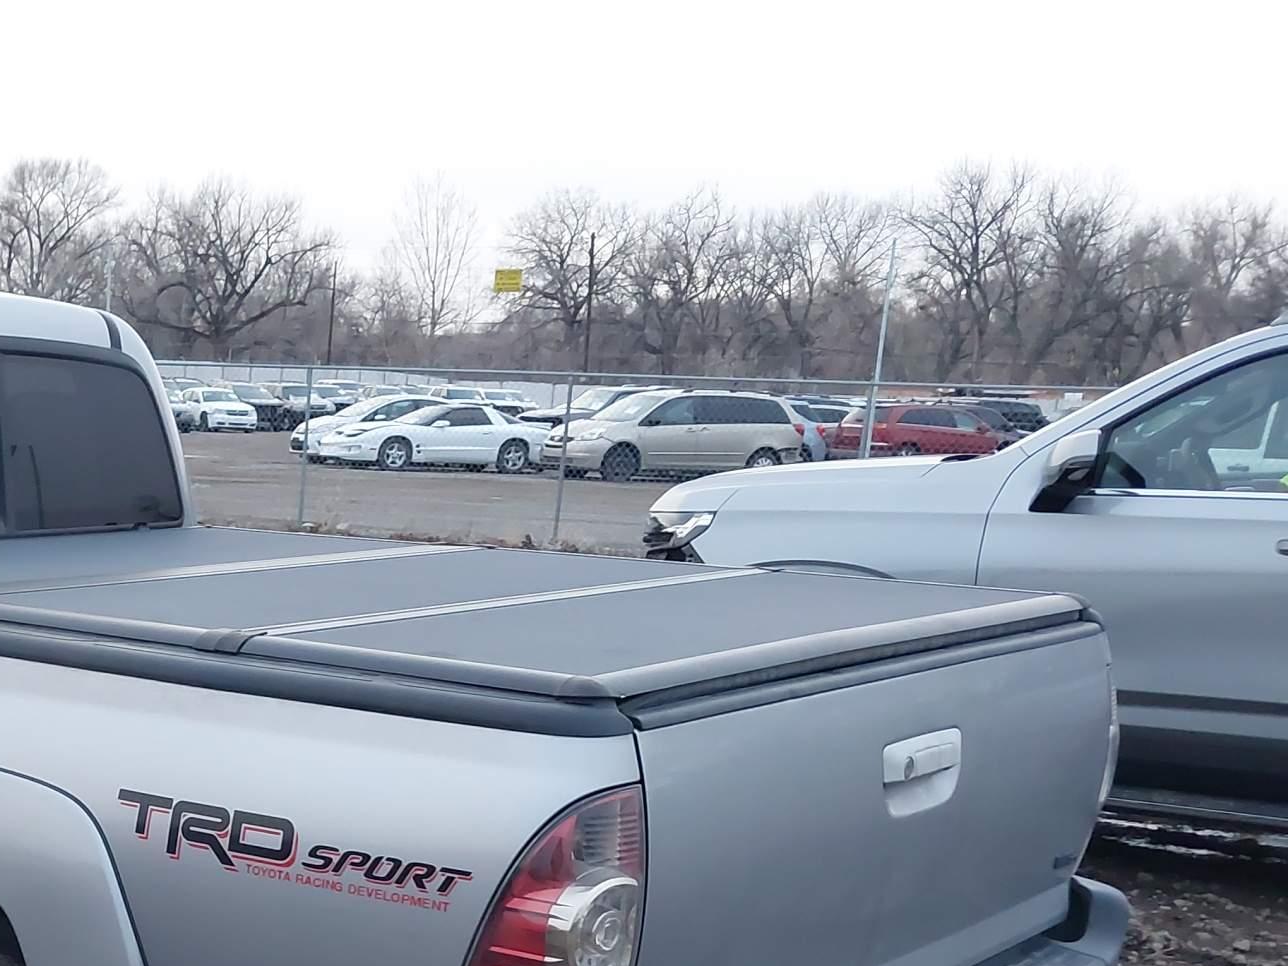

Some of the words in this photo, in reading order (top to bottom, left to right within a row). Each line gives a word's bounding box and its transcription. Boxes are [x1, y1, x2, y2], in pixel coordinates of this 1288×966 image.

[117, 788, 300, 871] TRD
[302, 844, 473, 897] SPORT
[245, 863, 292, 883] TOYOTA
[296, 873, 344, 893] RACING
[348, 883, 451, 914] DEVELOPMENT
